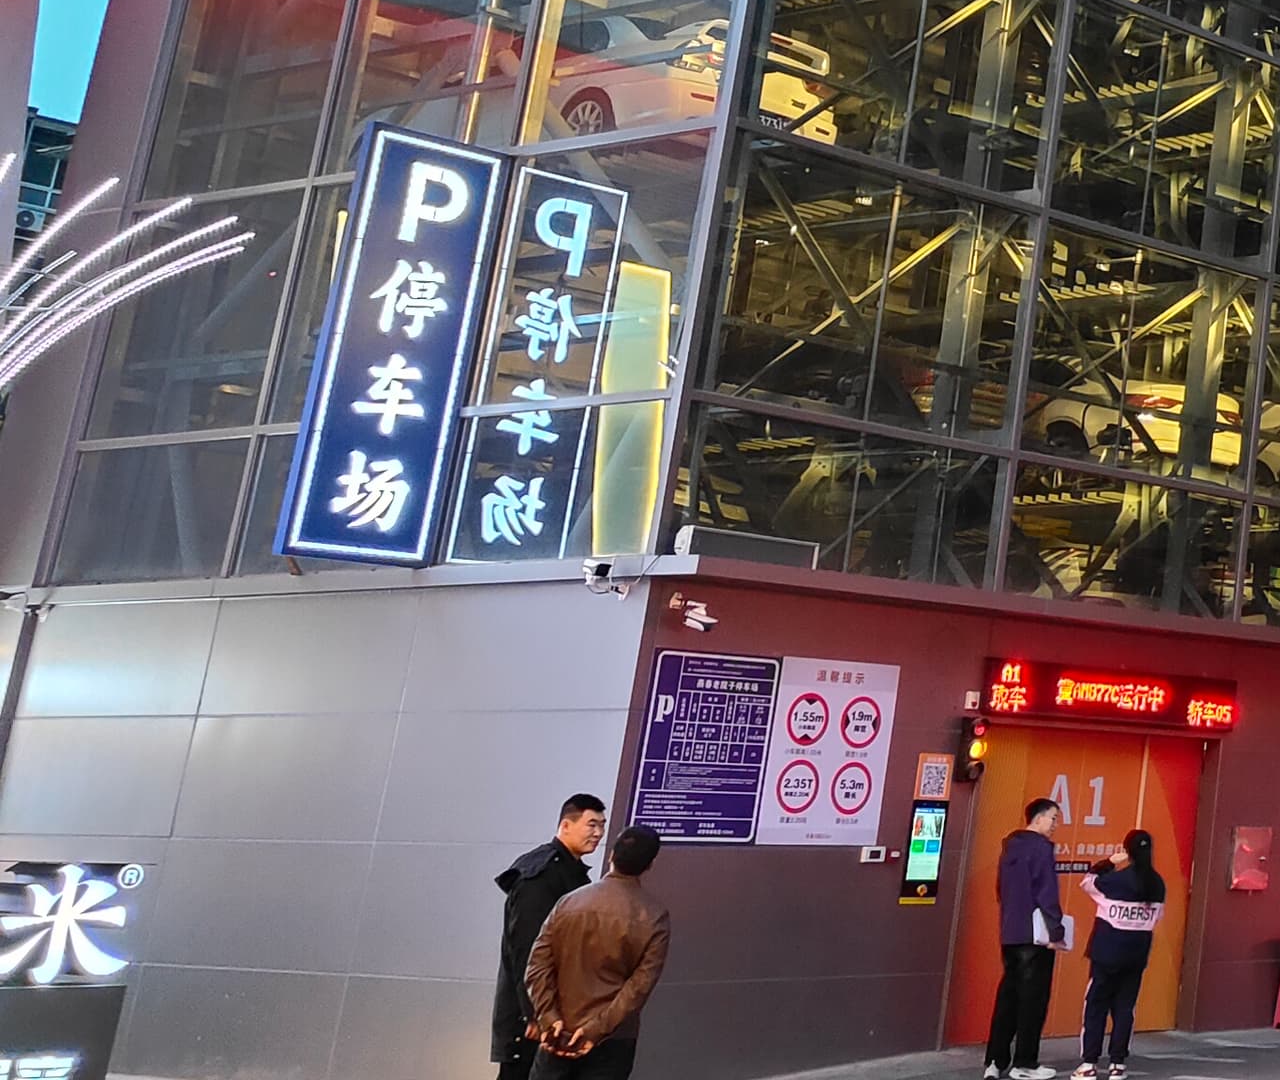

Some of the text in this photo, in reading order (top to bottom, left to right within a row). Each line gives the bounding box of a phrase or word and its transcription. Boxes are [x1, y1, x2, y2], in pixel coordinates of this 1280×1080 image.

[815, 669, 865, 685] 温馨提示
[1001, 663, 1021, 683] A1
[654, 694, 675, 723] P
[793, 711, 825, 723] 1.55m
[851, 710, 873, 722] 1.9m
[783, 778, 814, 790] 2.35T
[839, 779, 865, 791] 5.3m
[0, 863, 130, 985] 米
